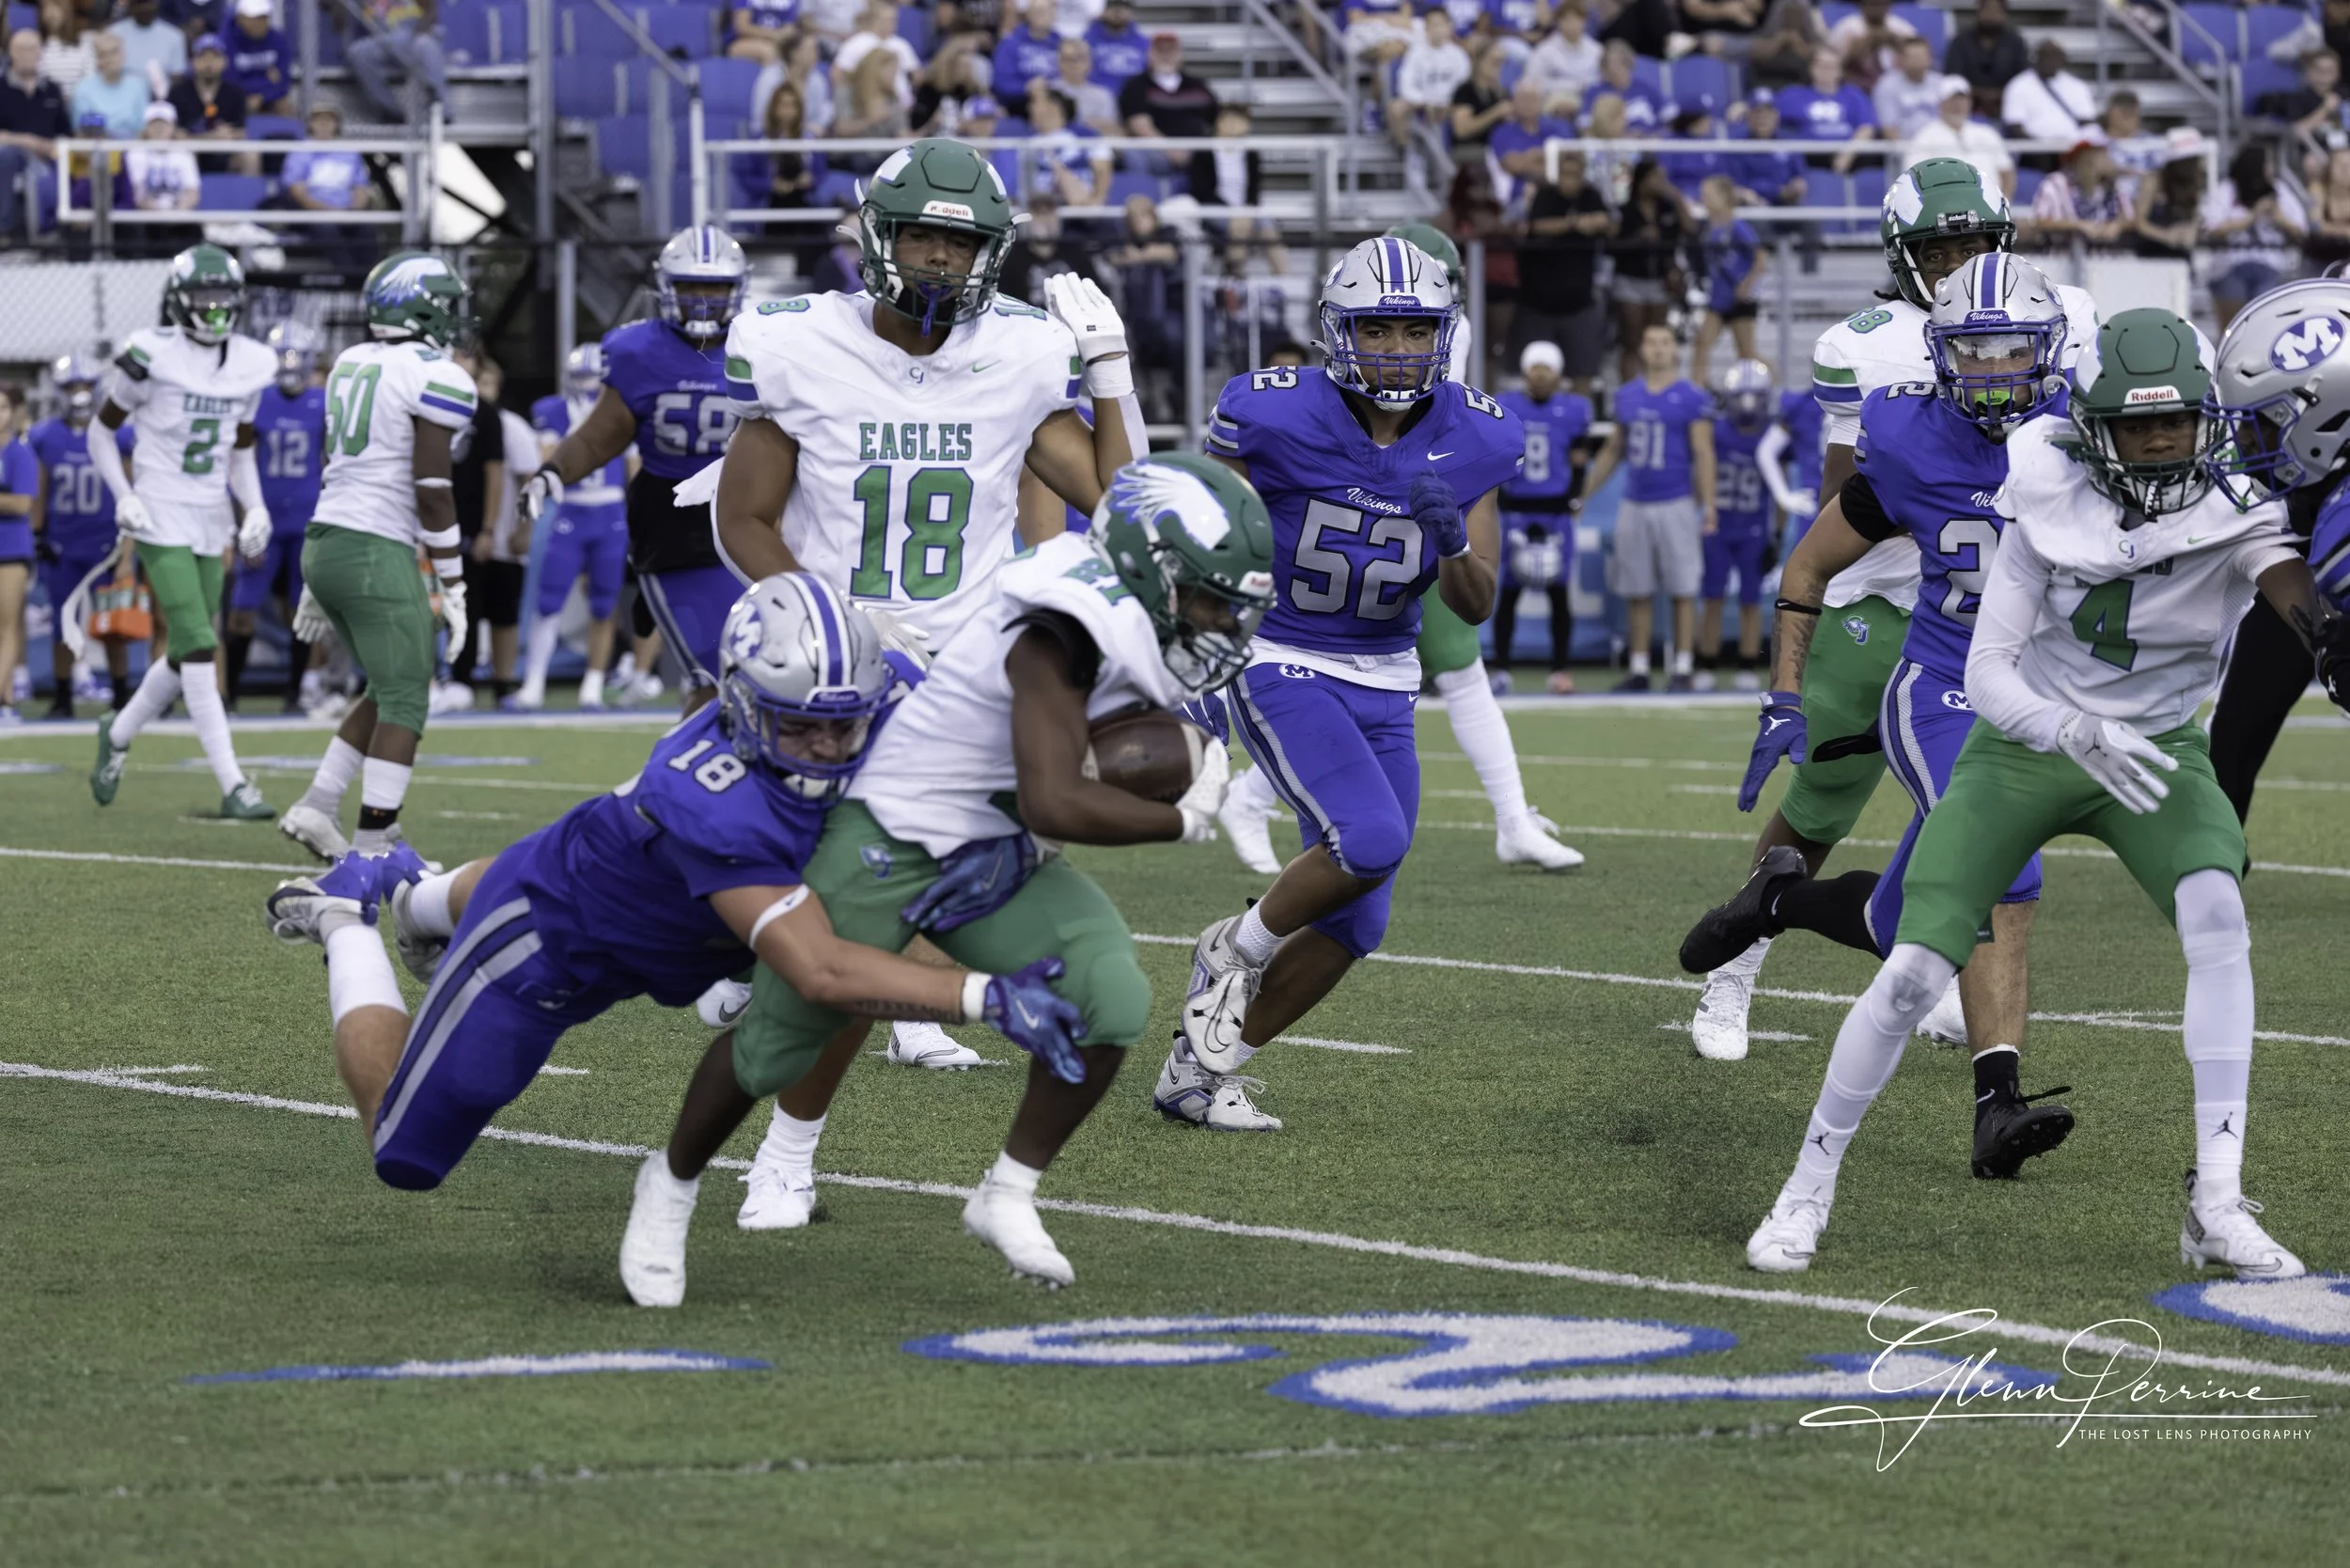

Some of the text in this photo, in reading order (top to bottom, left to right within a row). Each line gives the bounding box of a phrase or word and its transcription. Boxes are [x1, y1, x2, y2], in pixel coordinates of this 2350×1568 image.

[1384, 295, 1416, 306] Vikings
[1969, 311, 2004, 322] Vikings
[2273, 317, 2341, 371] M
[325, 361, 383, 458] 50
[2131, 389, 2174, 402] Riddell
[182, 417, 221, 474] 2
[267, 429, 310, 478] 12
[858, 422, 972, 462] EAGLES
[1627, 421, 1668, 469] 91
[53, 463, 103, 515] 20
[1346, 487, 1402, 515] Vikings
[850, 464, 974, 601] 18
[1289, 494, 1424, 621] 52
[2068, 576, 2138, 673] 4
[1285, 665, 1311, 679] M
[667, 739, 748, 794] 18
